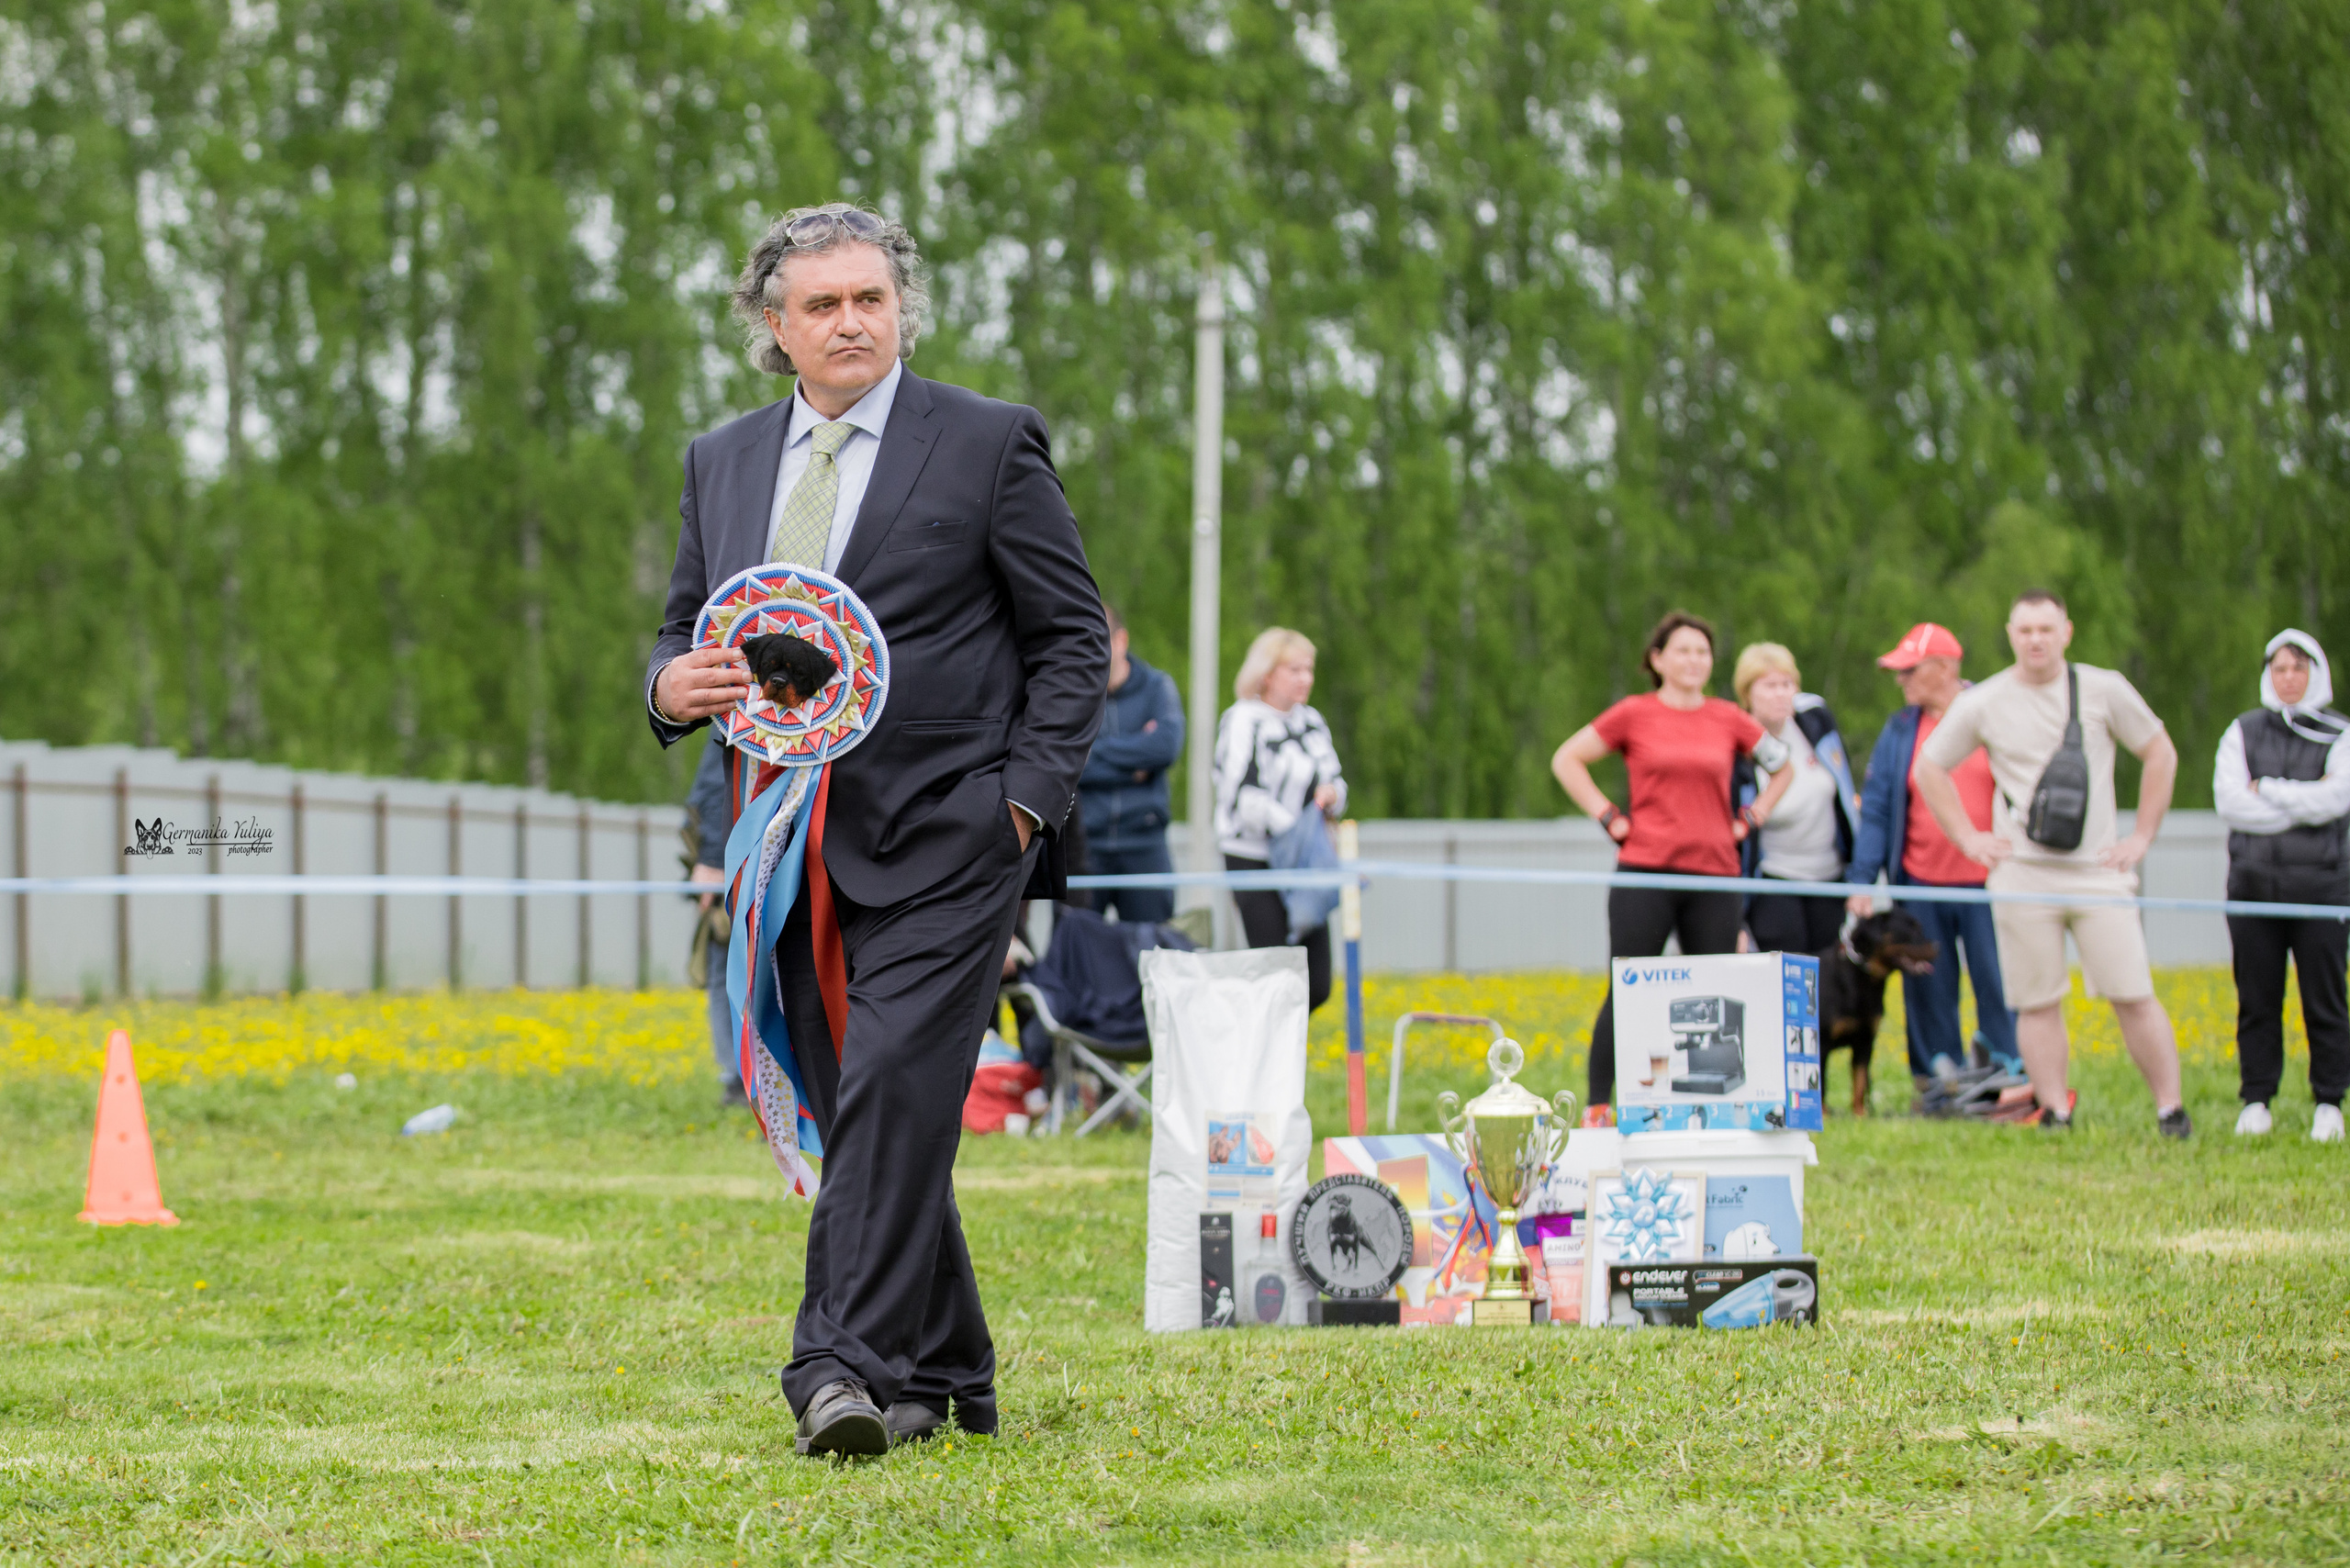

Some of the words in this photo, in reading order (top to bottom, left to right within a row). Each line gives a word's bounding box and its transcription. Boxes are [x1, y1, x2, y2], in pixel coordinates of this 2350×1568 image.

[1642, 969, 1692, 981] VITEK
[1621, 1107, 1628, 1120] 1
[1665, 1105, 1673, 1118] 2
[1711, 1103, 1718, 1116] 3
[1751, 1103, 1760, 1115] 4
[1309, 1173, 1394, 1201] ПРЕДСТАВИТЕЛЬ
[1712, 1193, 1743, 1204] Fabric
[1294, 1203, 1311, 1264] ЛУЧШИЙ
[1395, 1205, 1414, 1266] ПОРОДЫ
[1547, 1242, 1582, 1251] AMINO
[1632, 1269, 1688, 1283] endever
[1633, 1287, 1685, 1295] PORTABLE
